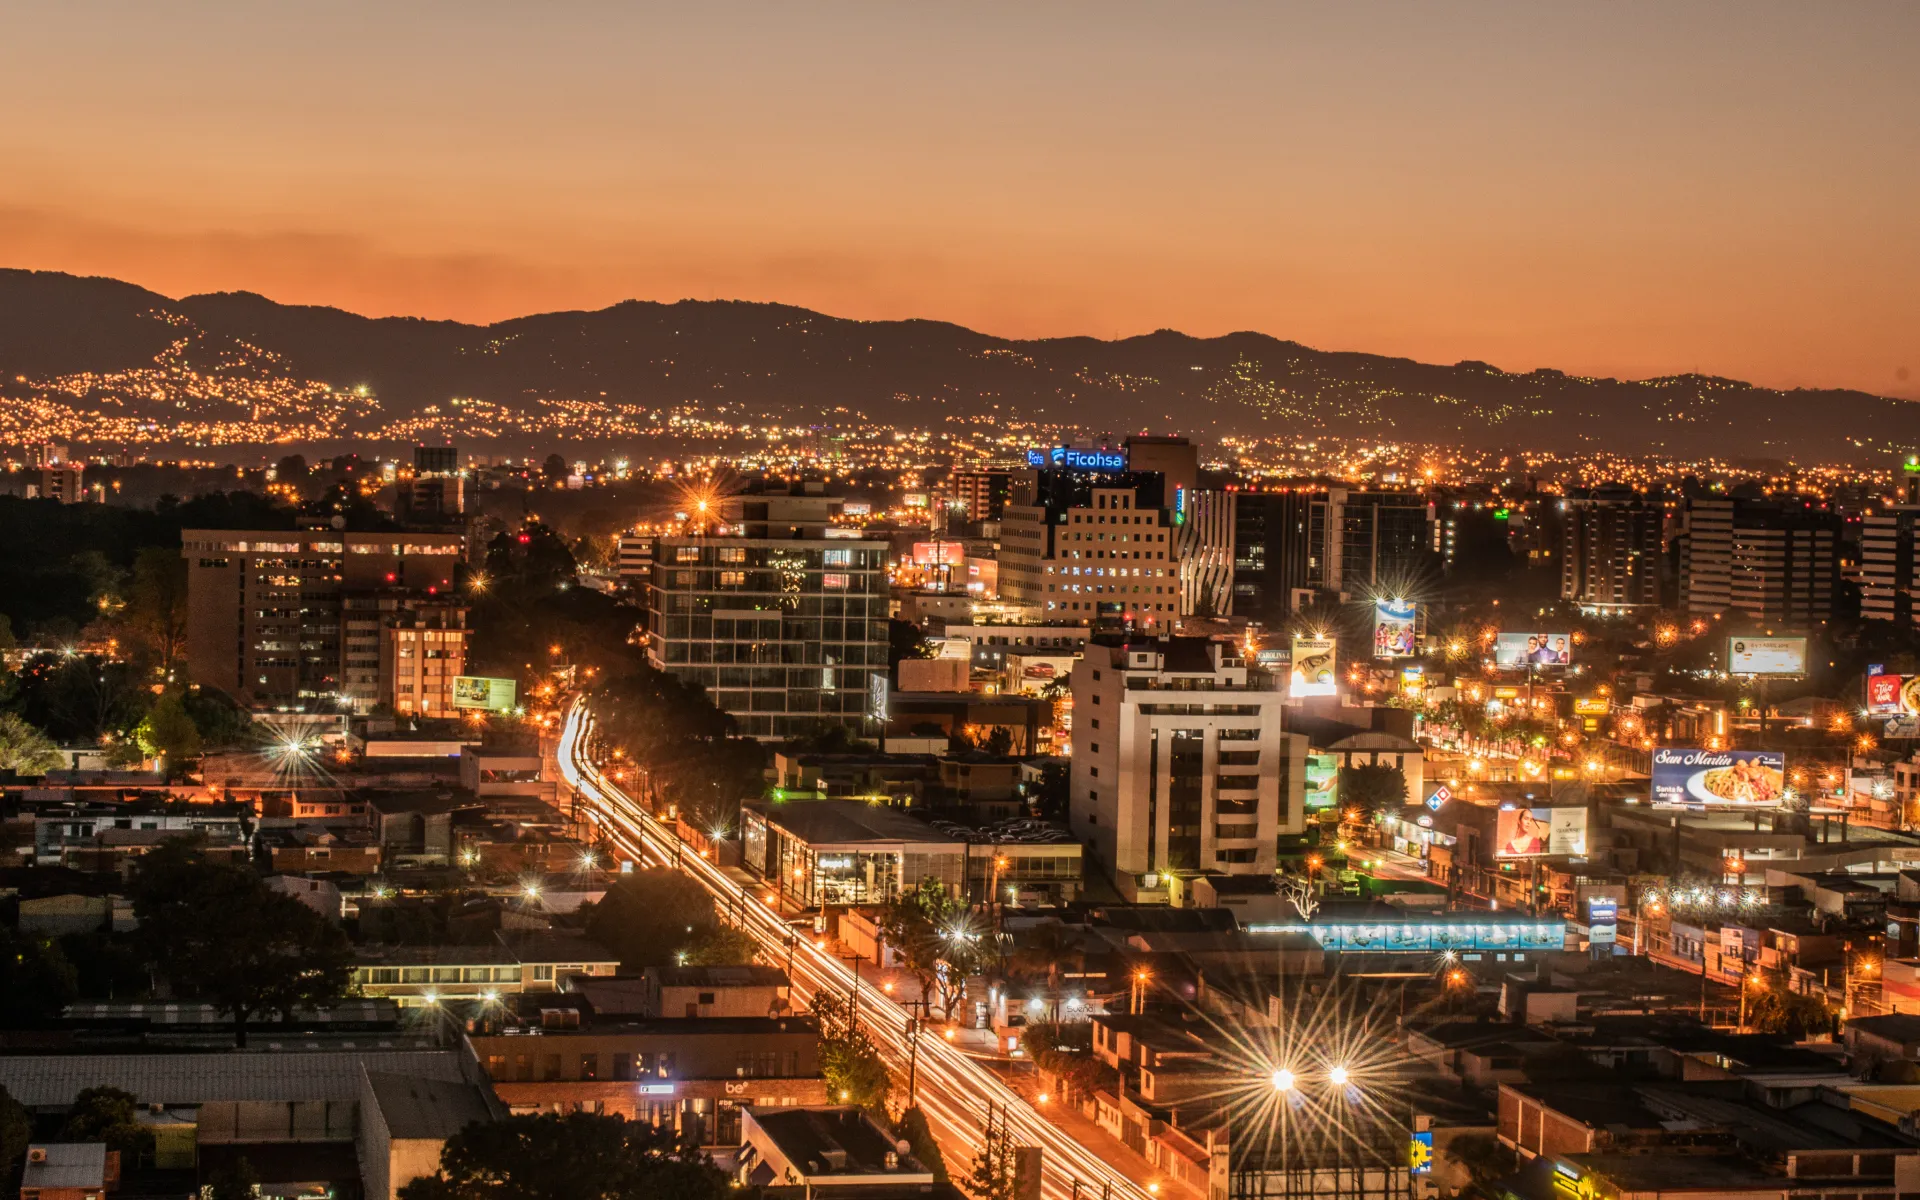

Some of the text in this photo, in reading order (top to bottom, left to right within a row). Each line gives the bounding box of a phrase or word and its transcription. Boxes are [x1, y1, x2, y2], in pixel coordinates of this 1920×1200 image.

[1066, 452, 1122, 467] Ficohsa
[1577, 703, 1606, 711] CAMPERO
[1655, 749, 1682, 764] San
